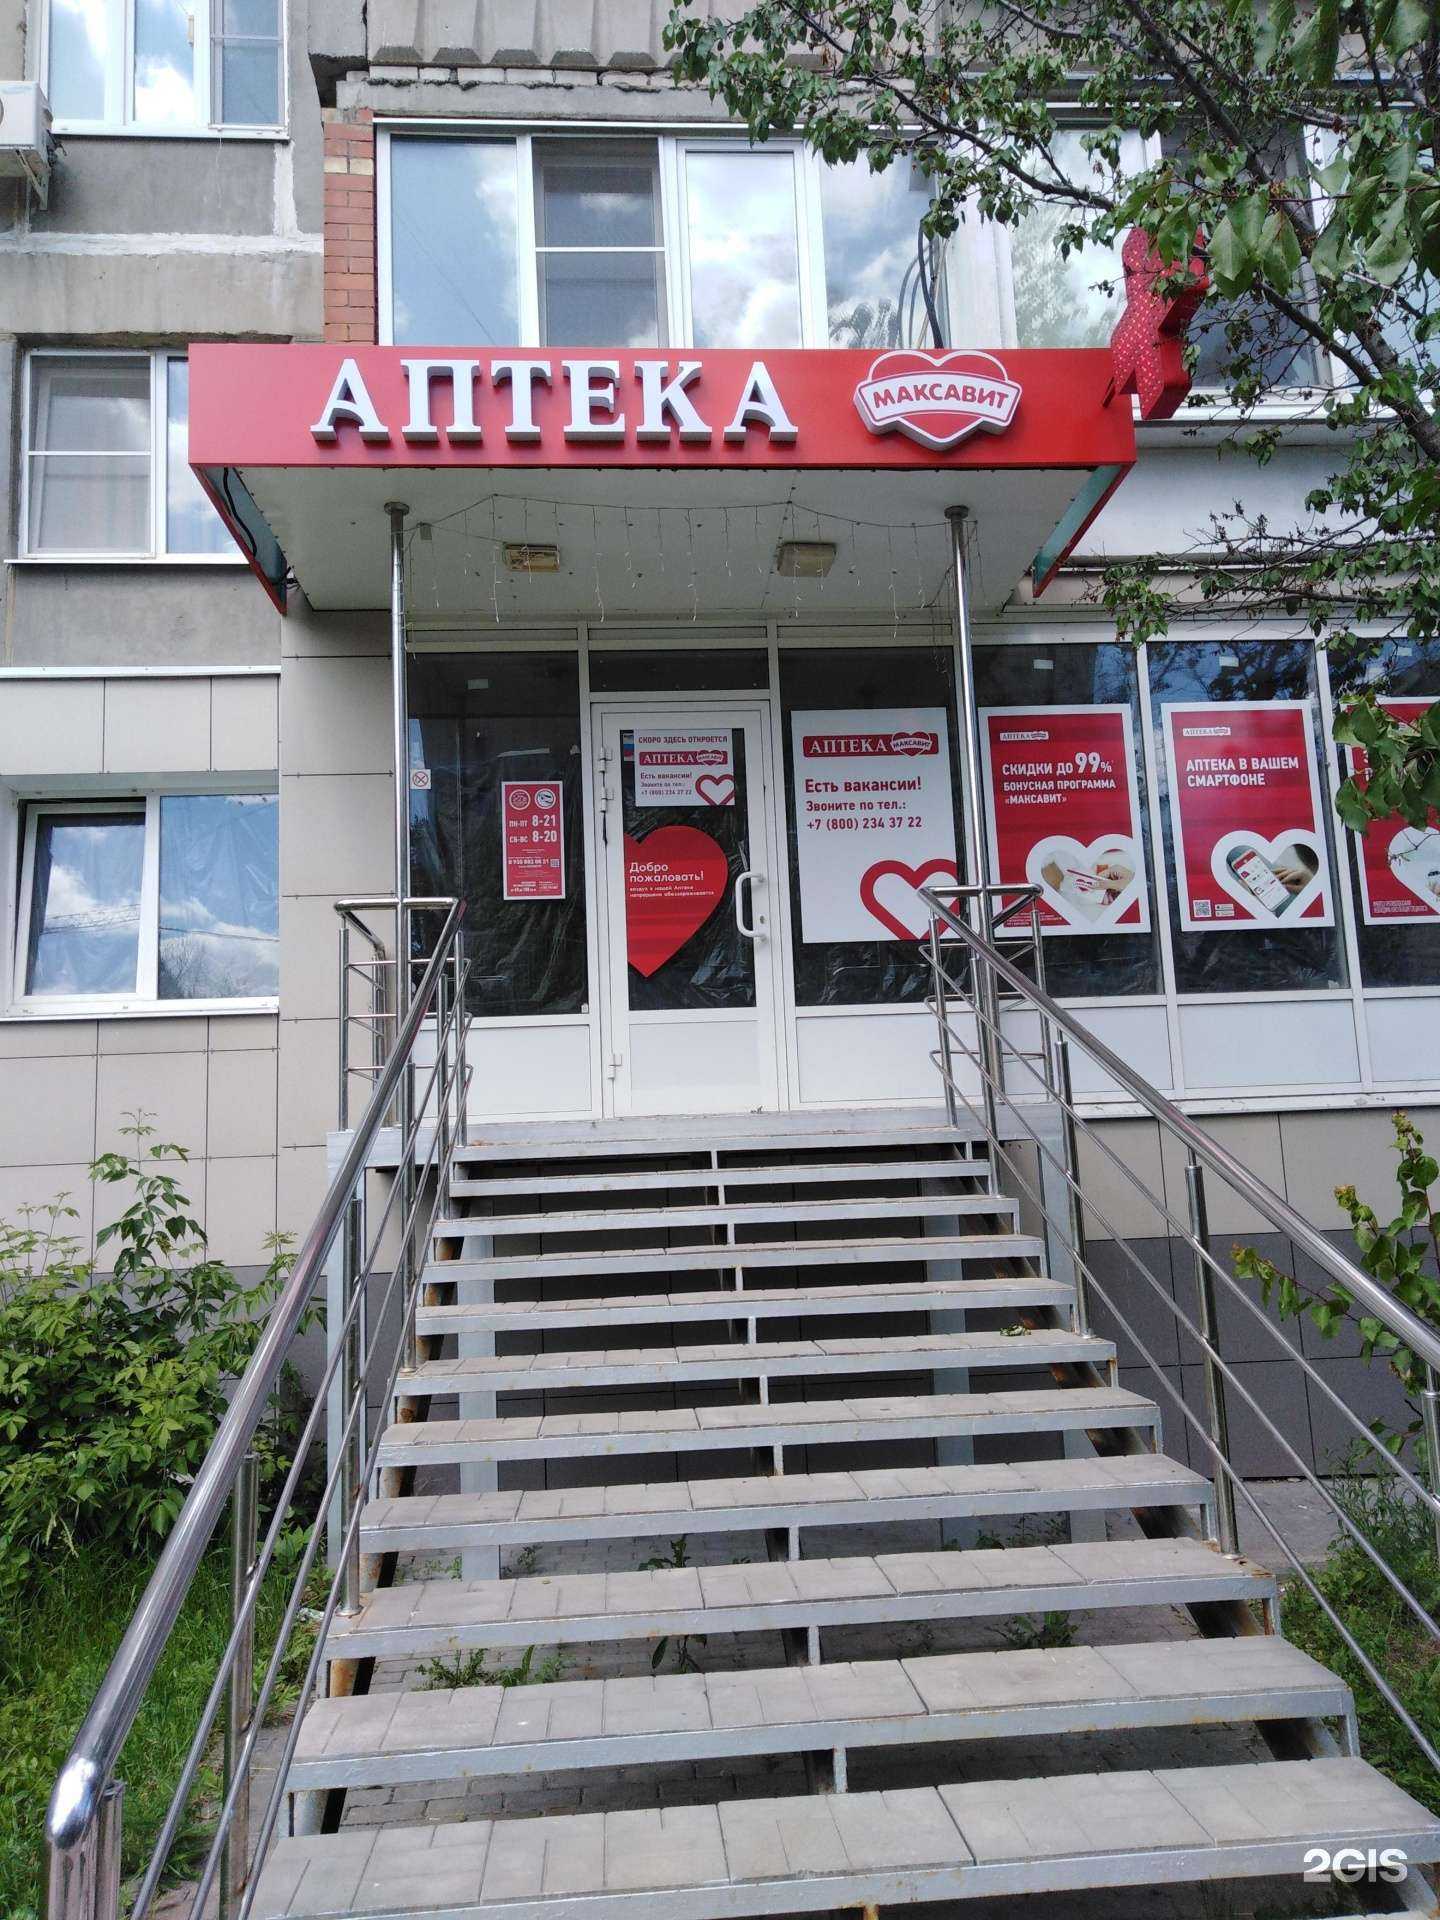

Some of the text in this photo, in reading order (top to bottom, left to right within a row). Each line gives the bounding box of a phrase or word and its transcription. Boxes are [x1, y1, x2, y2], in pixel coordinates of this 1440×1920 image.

[310, 358, 1009, 442] АПТЕКА МАКСАВИТ
[638, 735, 728, 744] СКОРО ЗДЕСЬ ОТКРОЕТСЯ
[809, 738, 932, 754] АПТЕКА МАКСАВИТ
[643, 753, 694, 764] АПТЕКА
[1186, 757, 1299, 772] АПТЕКА В ВАШЕМ
[1002, 762, 1053, 776] СКИДКИ
[1056, 762, 1074, 776] ДО
[640, 772, 656, 780] Есть
[1187, 773, 1266, 787] СМАРТФОНЕ
[805, 776, 922, 793] Есть вакансии!
[1003, 779, 1116, 792] БОНУСНАЯ ПРОГРАММА
[1005, 793, 1067, 805] «МАКСАВИТ»
[806, 800, 907, 812] Звоните по тел.:
[532, 814, 556, 827] 8-21
[807, 816, 922, 831] +7 (800) 234 37 22
[532, 831, 557, 843] 8-20
[630, 862, 669, 874] Добро
[630, 871, 704, 882] пожаловать!
